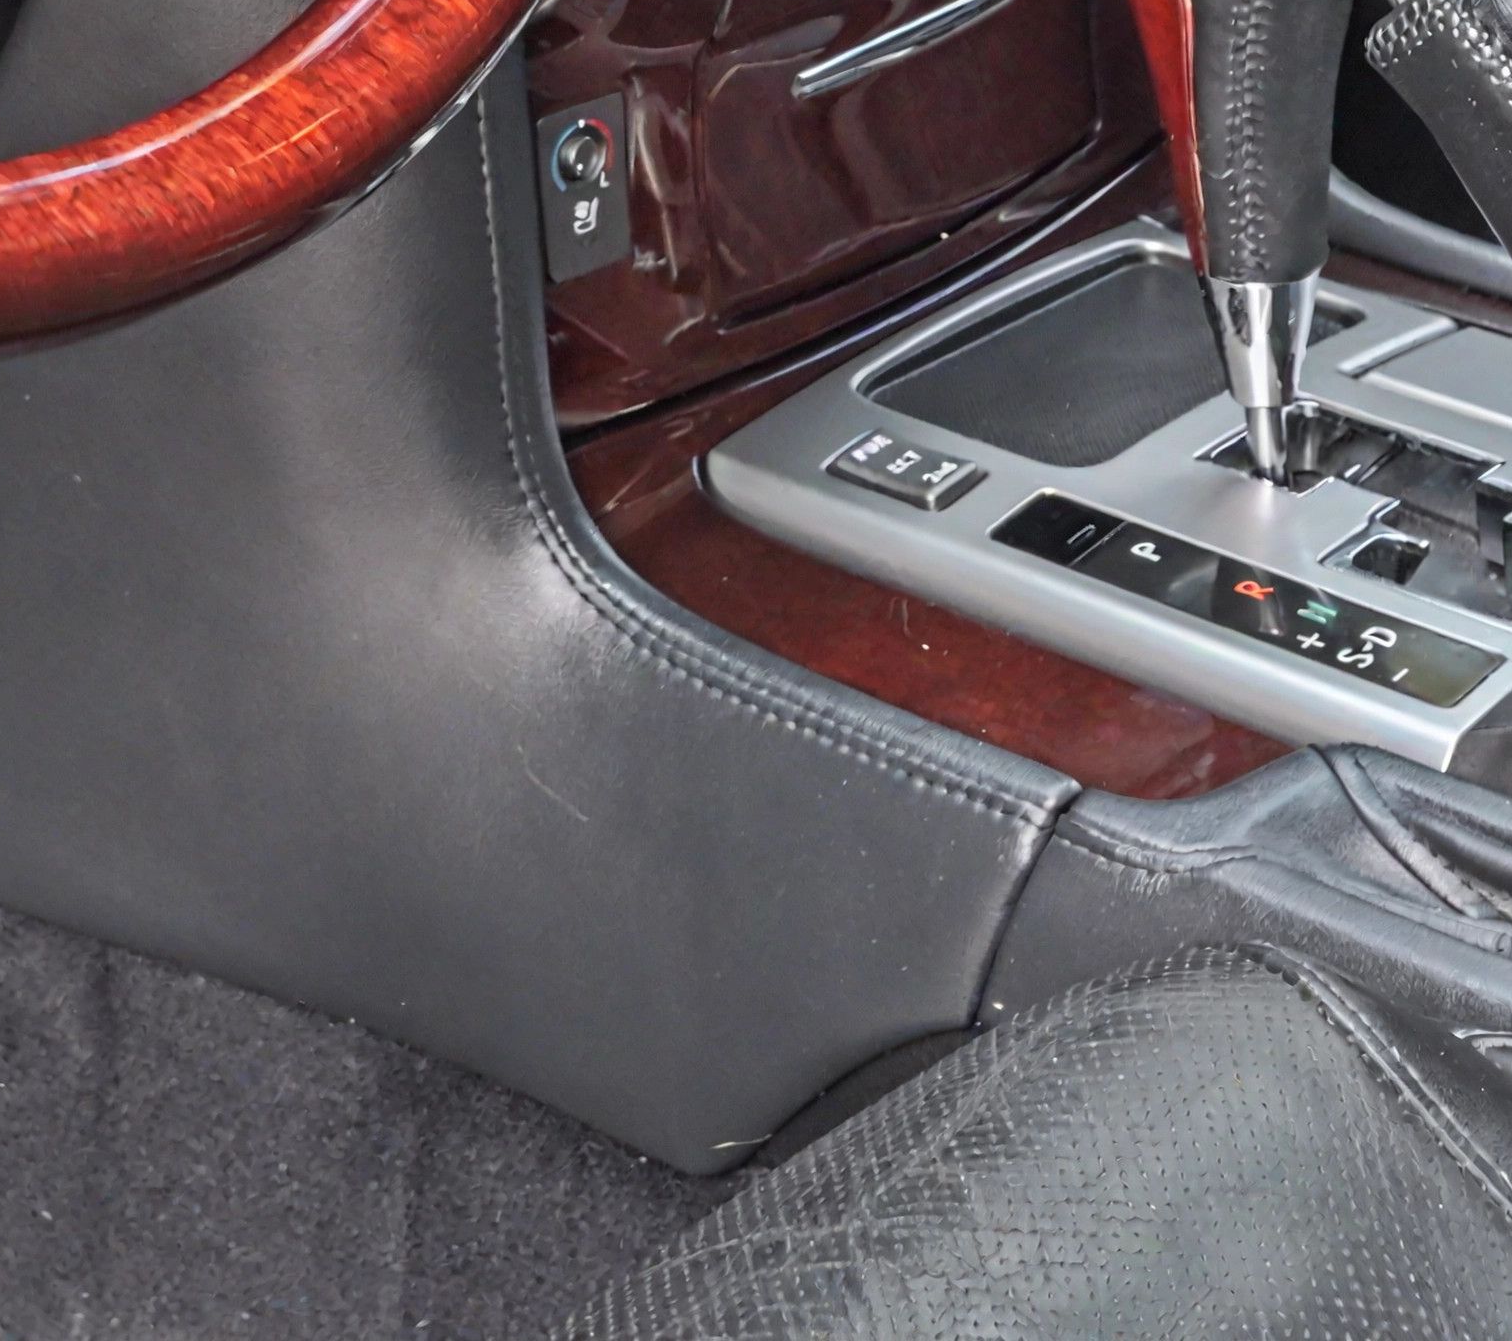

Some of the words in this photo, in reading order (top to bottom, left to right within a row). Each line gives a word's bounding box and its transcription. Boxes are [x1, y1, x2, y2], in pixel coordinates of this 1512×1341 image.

[1130, 541, 1161, 562] P
[1233, 580, 1274, 600] R
[1360, 625, 1397, 649] D
